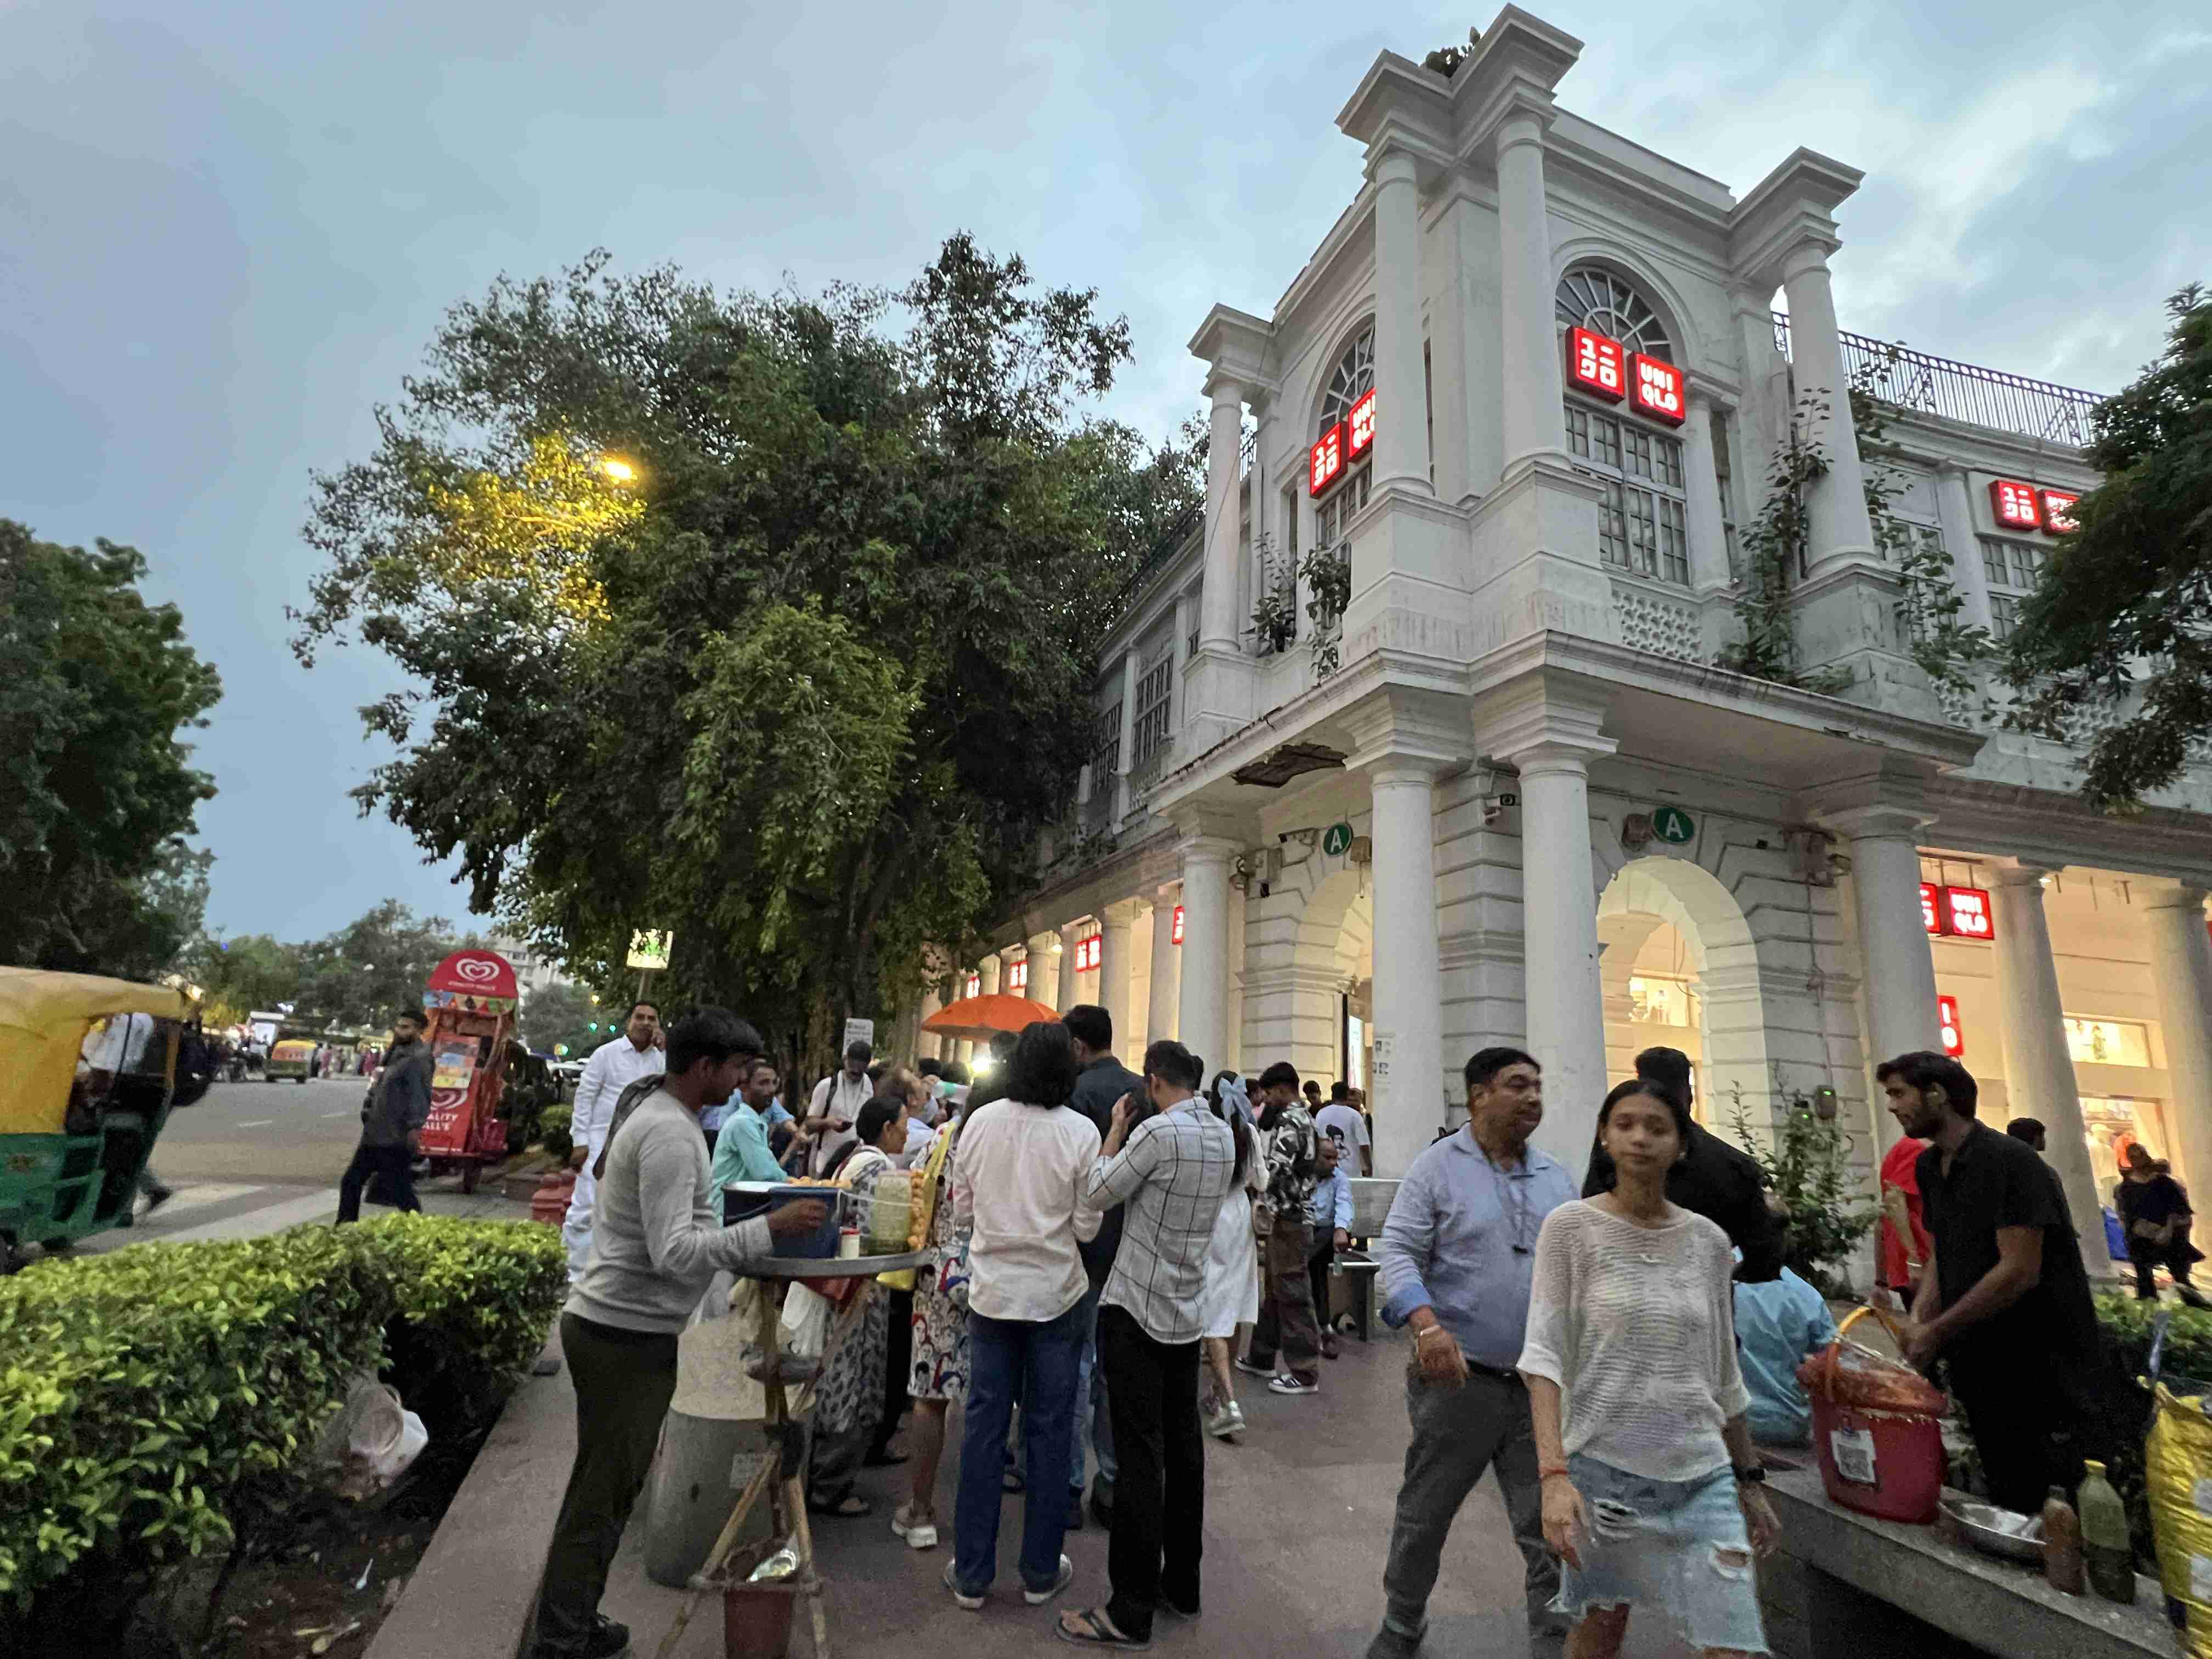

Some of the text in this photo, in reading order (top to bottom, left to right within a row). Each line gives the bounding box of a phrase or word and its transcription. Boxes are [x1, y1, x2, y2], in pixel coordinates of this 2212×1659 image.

[1640, 362, 1673, 392] UNI
[1641, 383, 1678, 411] QLO
[1353, 394, 1376, 429] UNI
[1665, 812, 1685, 839] A
[1330, 828, 1343, 853] A
[1951, 894, 1983, 913] UNI
[1955, 912, 1988, 933] QLO
